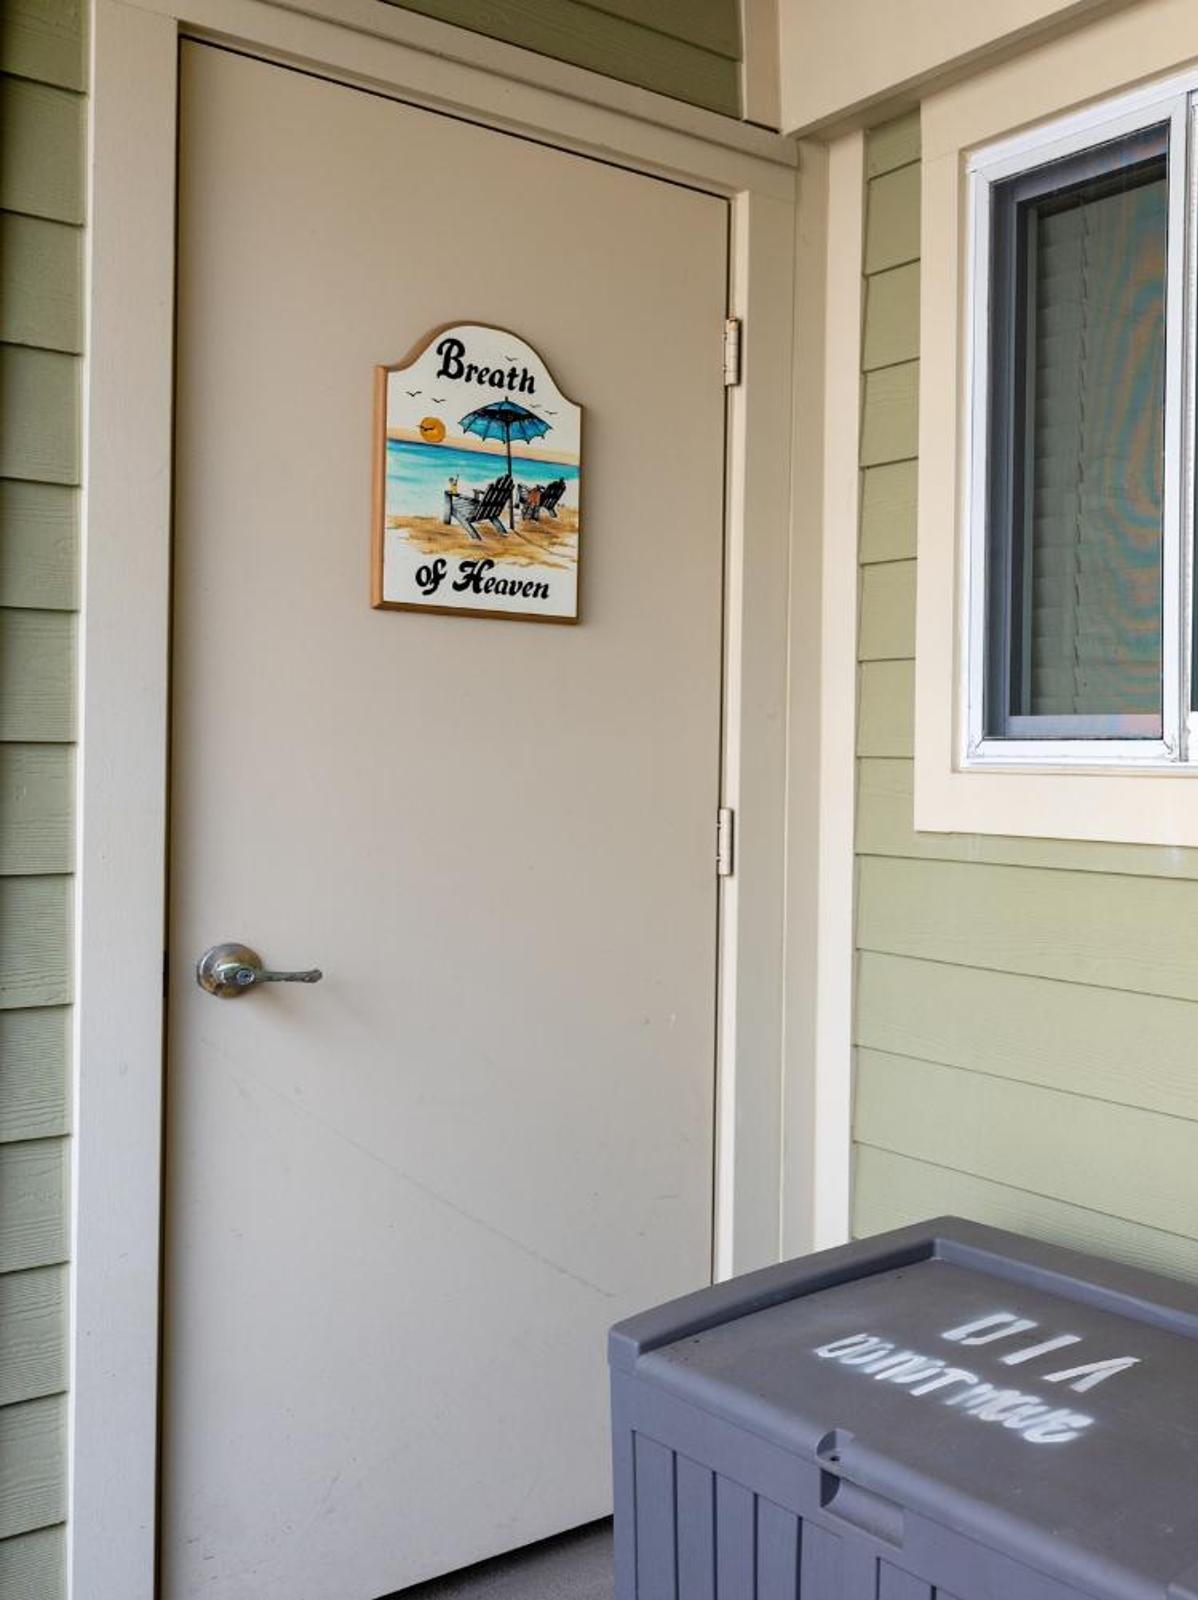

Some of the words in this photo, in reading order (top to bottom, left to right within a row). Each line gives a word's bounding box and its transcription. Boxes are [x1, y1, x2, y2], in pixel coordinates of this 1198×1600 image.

[436, 338, 536, 394] Breath
[415, 558, 447, 596] of
[452, 558, 550, 599] Heaven
